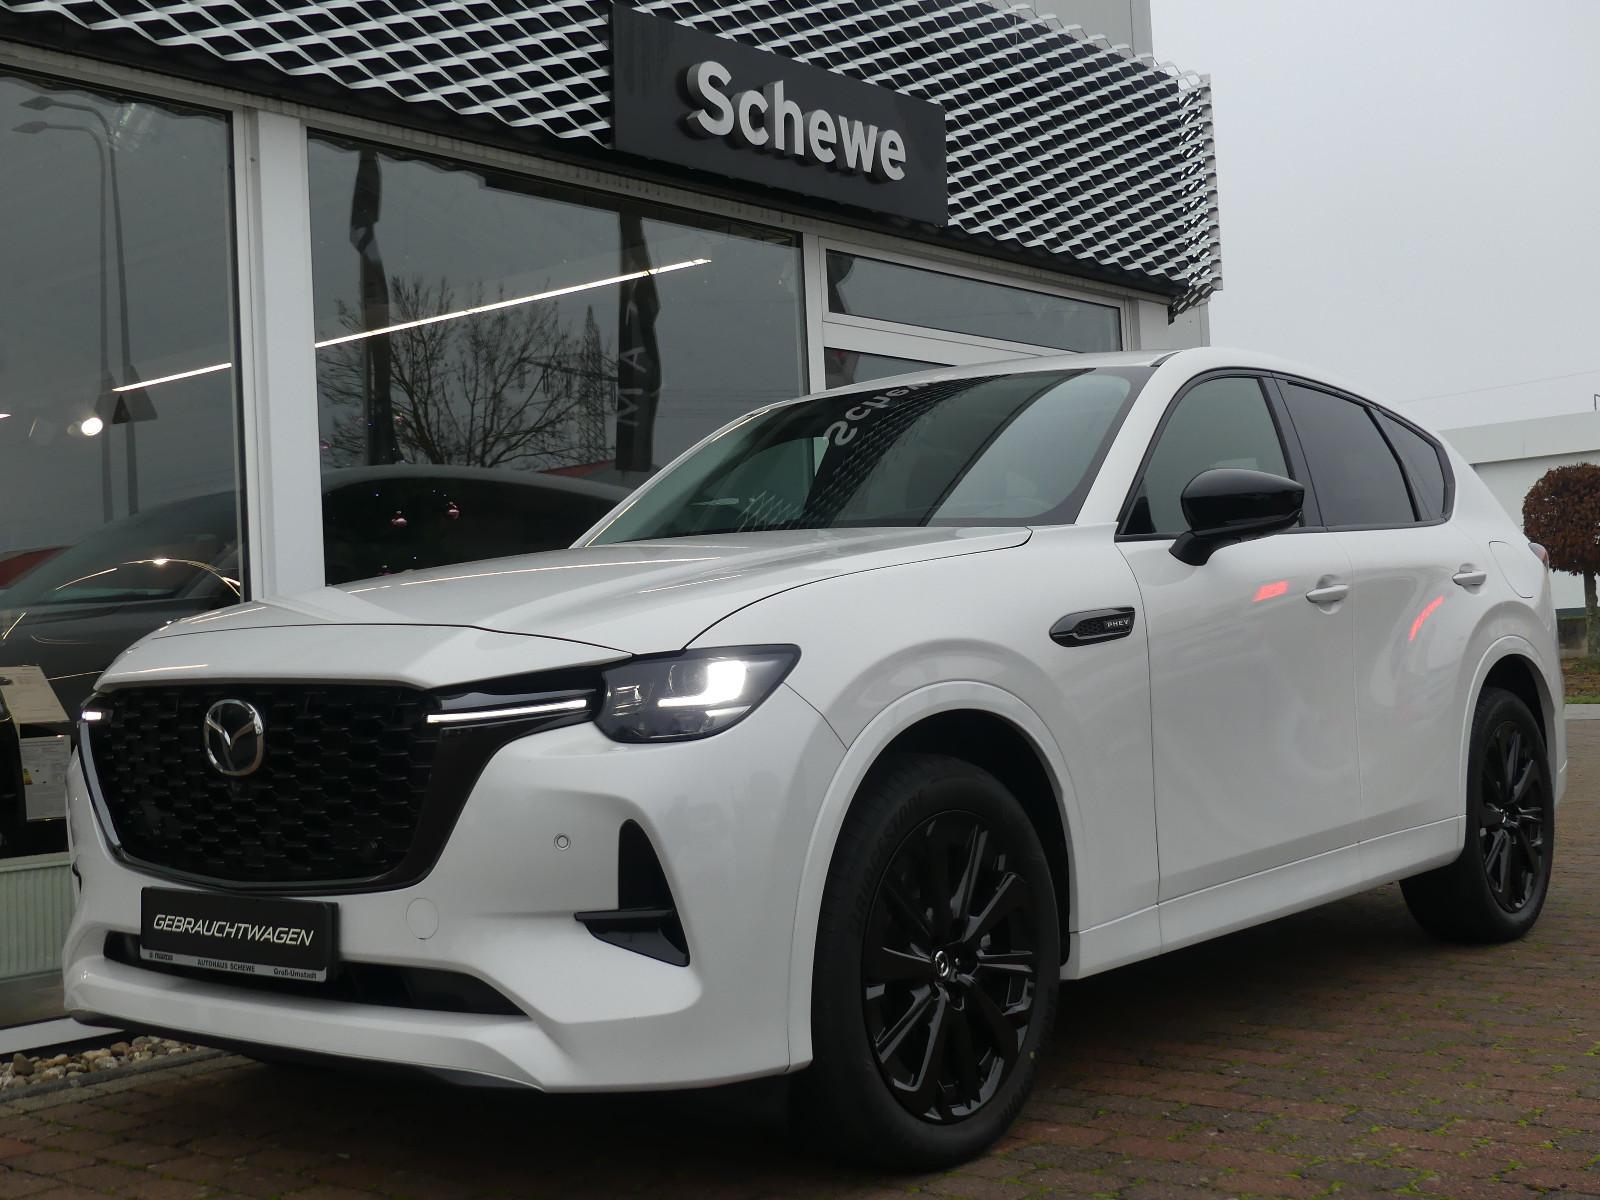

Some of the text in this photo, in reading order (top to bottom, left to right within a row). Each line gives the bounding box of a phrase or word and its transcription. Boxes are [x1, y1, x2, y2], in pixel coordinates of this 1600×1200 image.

[688, 61, 906, 181] Schewe
[1106, 619, 1129, 628] PHEV
[153, 914, 315, 947] GEBRAUCHTWAGEN
[197, 959, 228, 970] AUTOHAUS
[230, 961, 256, 973] SCHEWE
